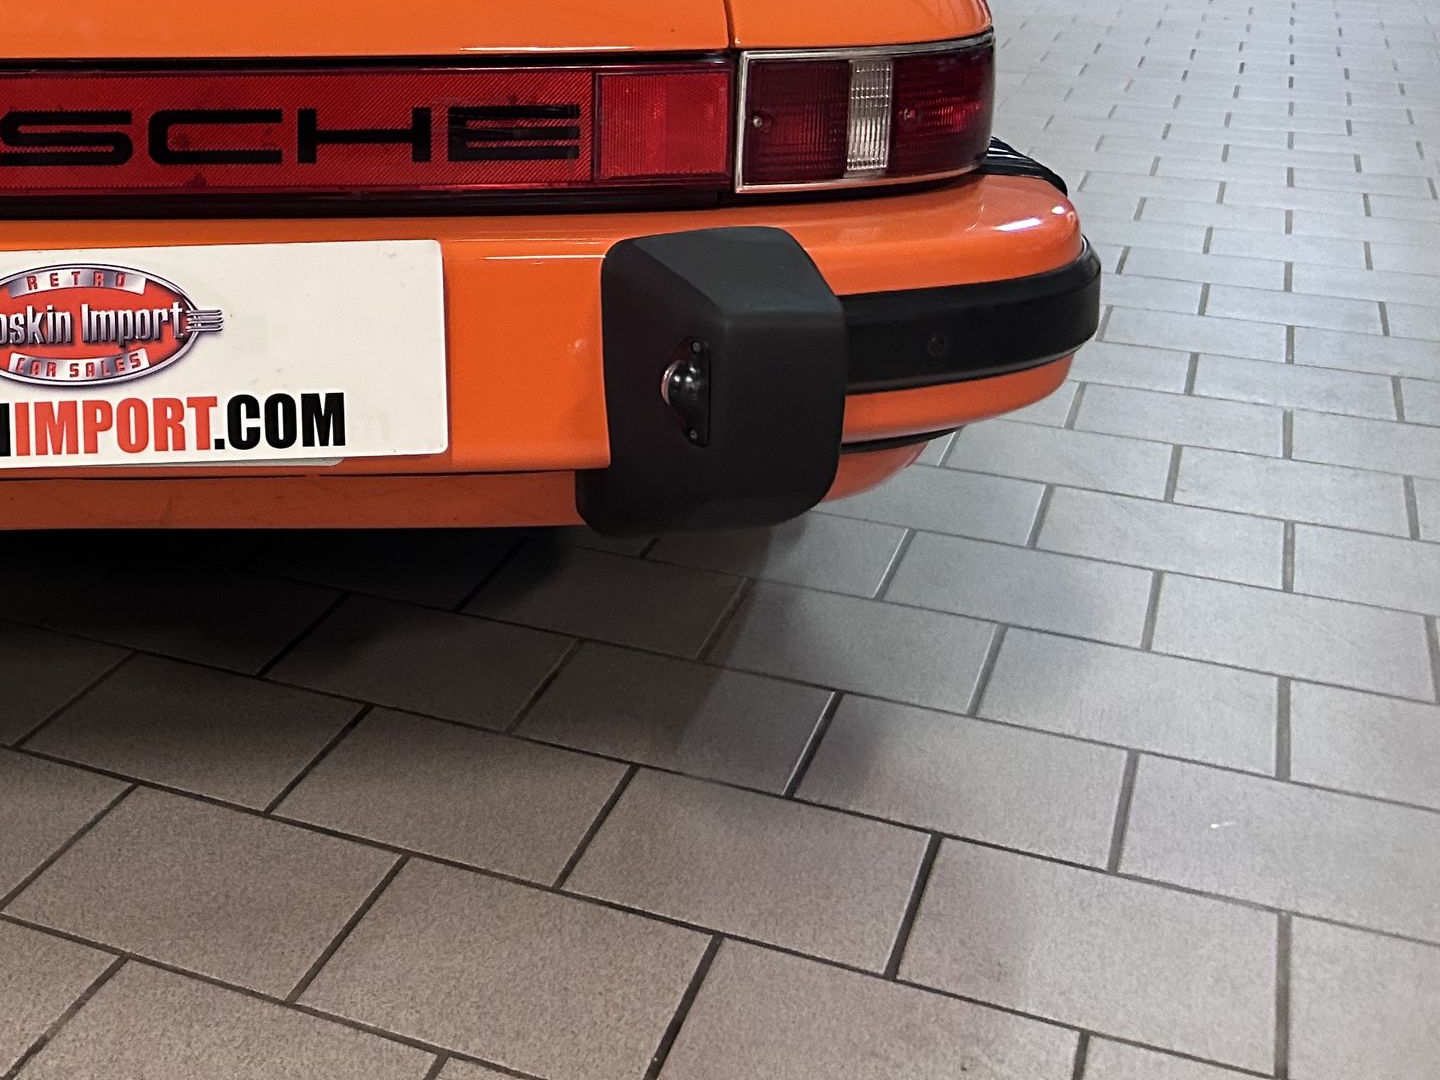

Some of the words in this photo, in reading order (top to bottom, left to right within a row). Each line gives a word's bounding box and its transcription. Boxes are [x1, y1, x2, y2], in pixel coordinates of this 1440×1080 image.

[26, 270, 126, 291] RETRO
[81, 301, 184, 347] Import
[15, 356, 57, 377] CAR
[69, 351, 142, 377] SALES
